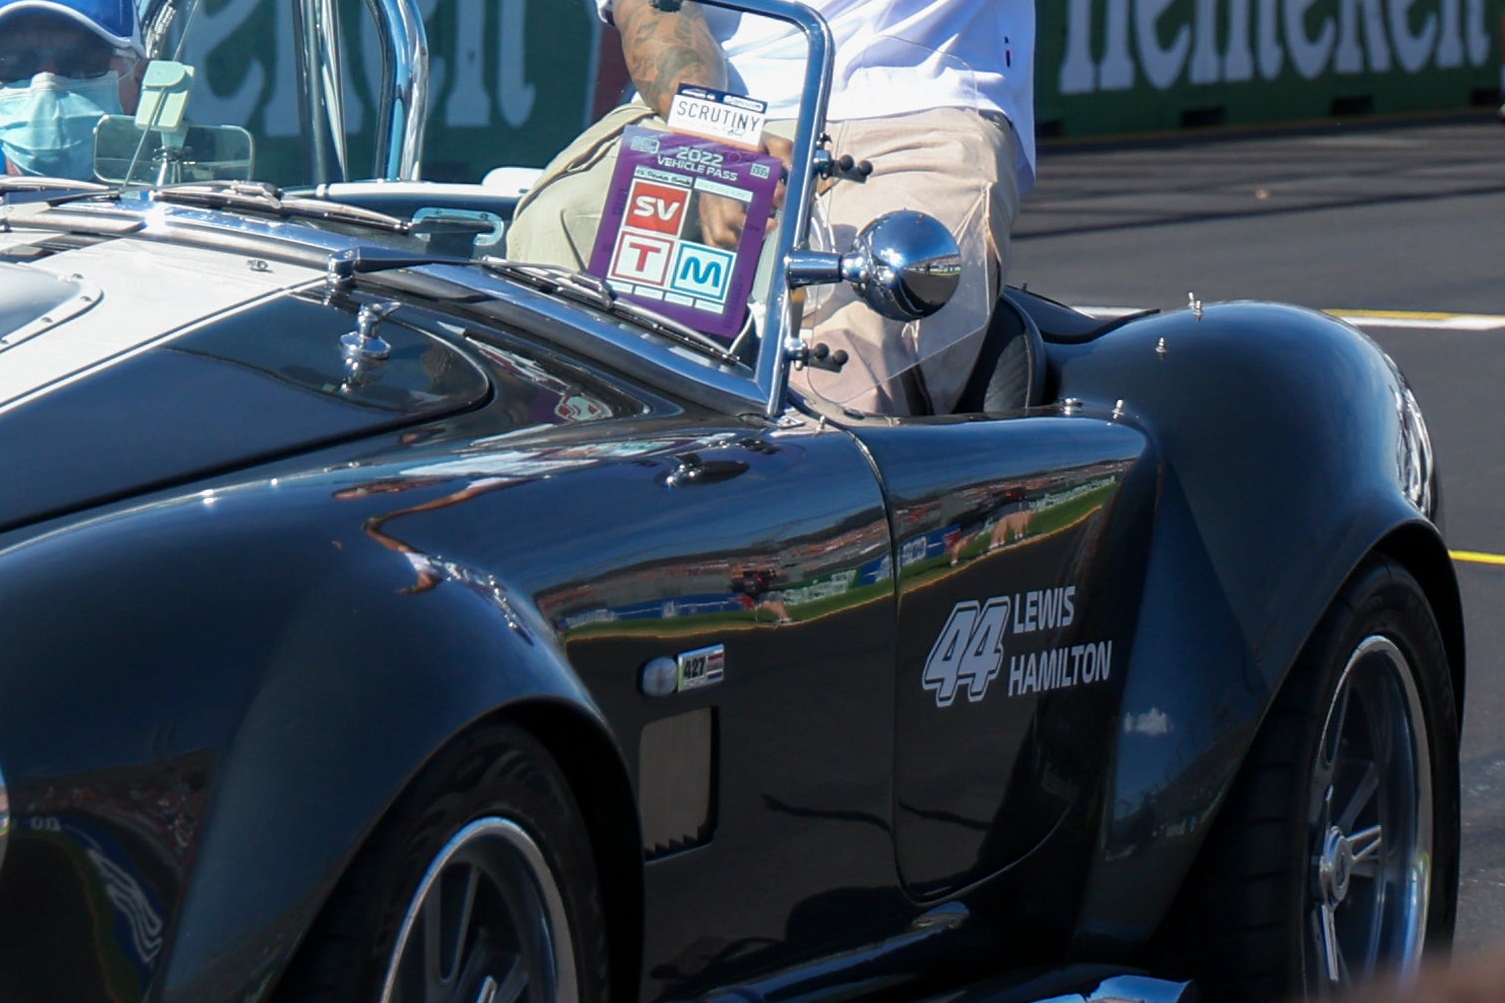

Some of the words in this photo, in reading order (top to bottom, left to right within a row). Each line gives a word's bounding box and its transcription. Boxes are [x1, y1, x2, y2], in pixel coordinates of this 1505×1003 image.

[676, 100, 761, 133] SCRUTINY
[657, 153, 706, 176] VEHICLE
[705, 166, 739, 183] PASS
[675, 145, 725, 169] 2022
[632, 194, 681, 222] SV
[628, 241, 662, 273] T
[679, 256, 722, 289] M
[1013, 585, 1076, 634] LEWIS
[922, 595, 1012, 708] 44
[1007, 639, 1113, 697] HAMILTON
